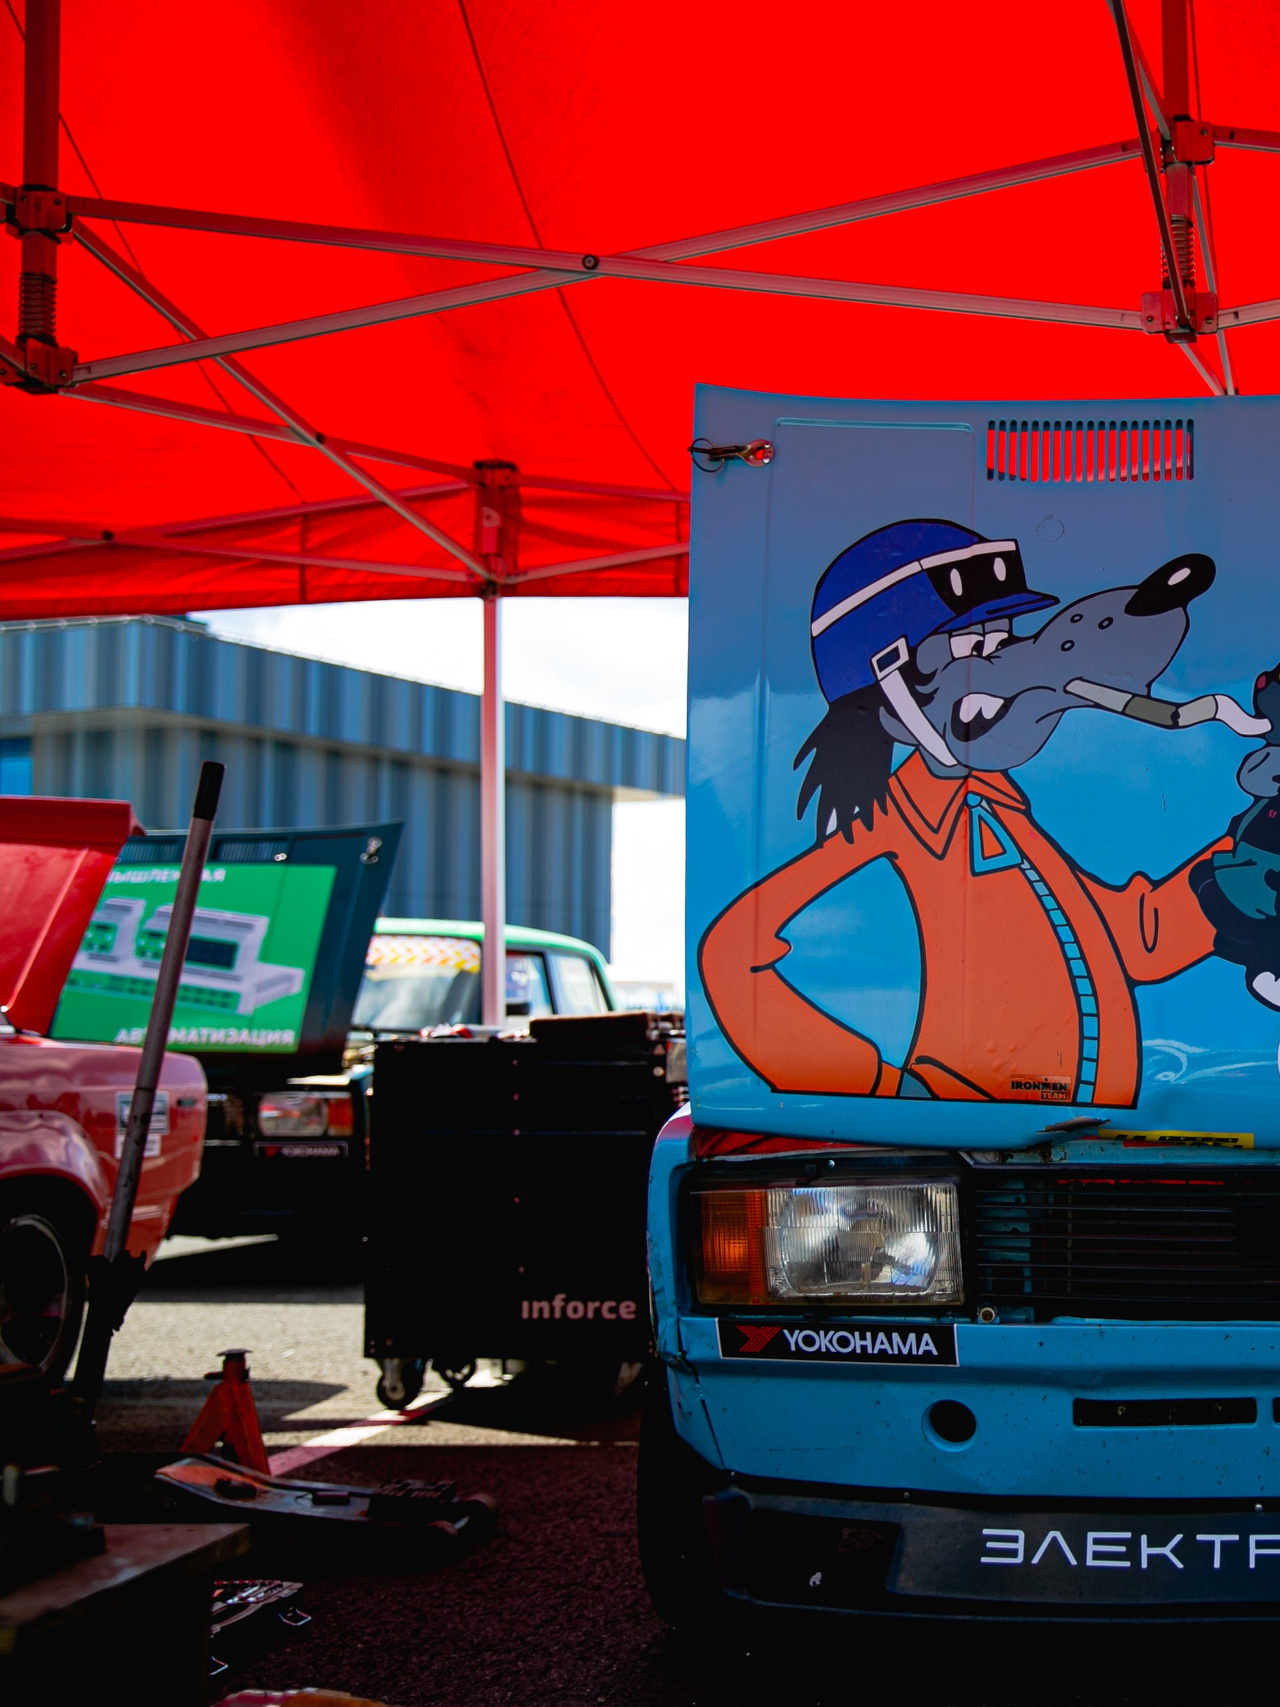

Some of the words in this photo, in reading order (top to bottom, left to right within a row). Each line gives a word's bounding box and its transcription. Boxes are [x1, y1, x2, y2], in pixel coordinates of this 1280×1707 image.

[1010, 1080, 1068, 1092] IRONMEN
[1041, 1091, 1067, 1100] TEAM
[520, 1293, 637, 1320] inforce
[783, 1328, 939, 1356] YOKOHAMA
